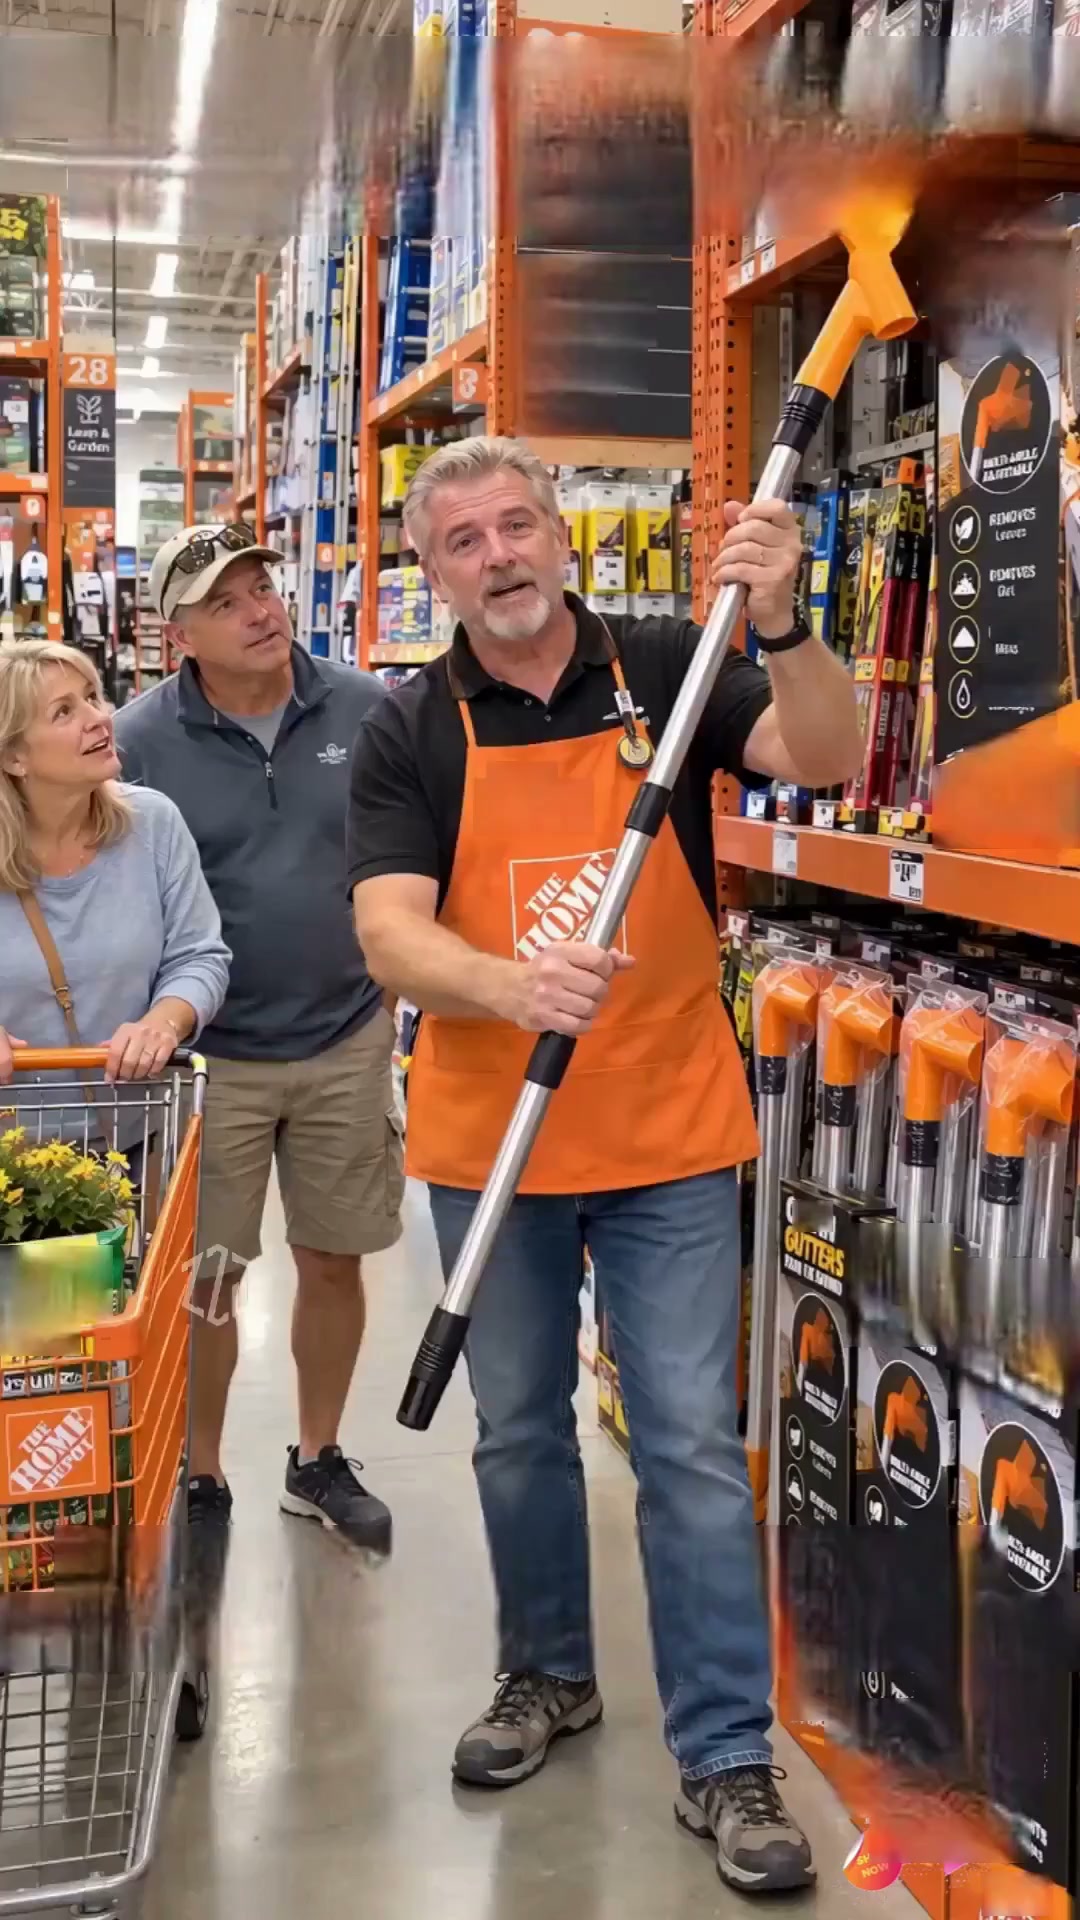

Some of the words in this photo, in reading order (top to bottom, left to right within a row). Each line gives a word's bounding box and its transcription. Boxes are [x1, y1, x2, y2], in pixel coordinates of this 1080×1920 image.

[68, 356, 109, 385] 28
[68, 426, 98, 438] Lawn
[68, 440, 110, 452] Garden
[524, 872, 567, 915] THE
[784, 1225, 845, 1277] GUTTERS
[10, 1408, 92, 1492] HOME
[18, 1420, 53, 1453] THE
[42, 1439, 94, 1488] DEPOT
